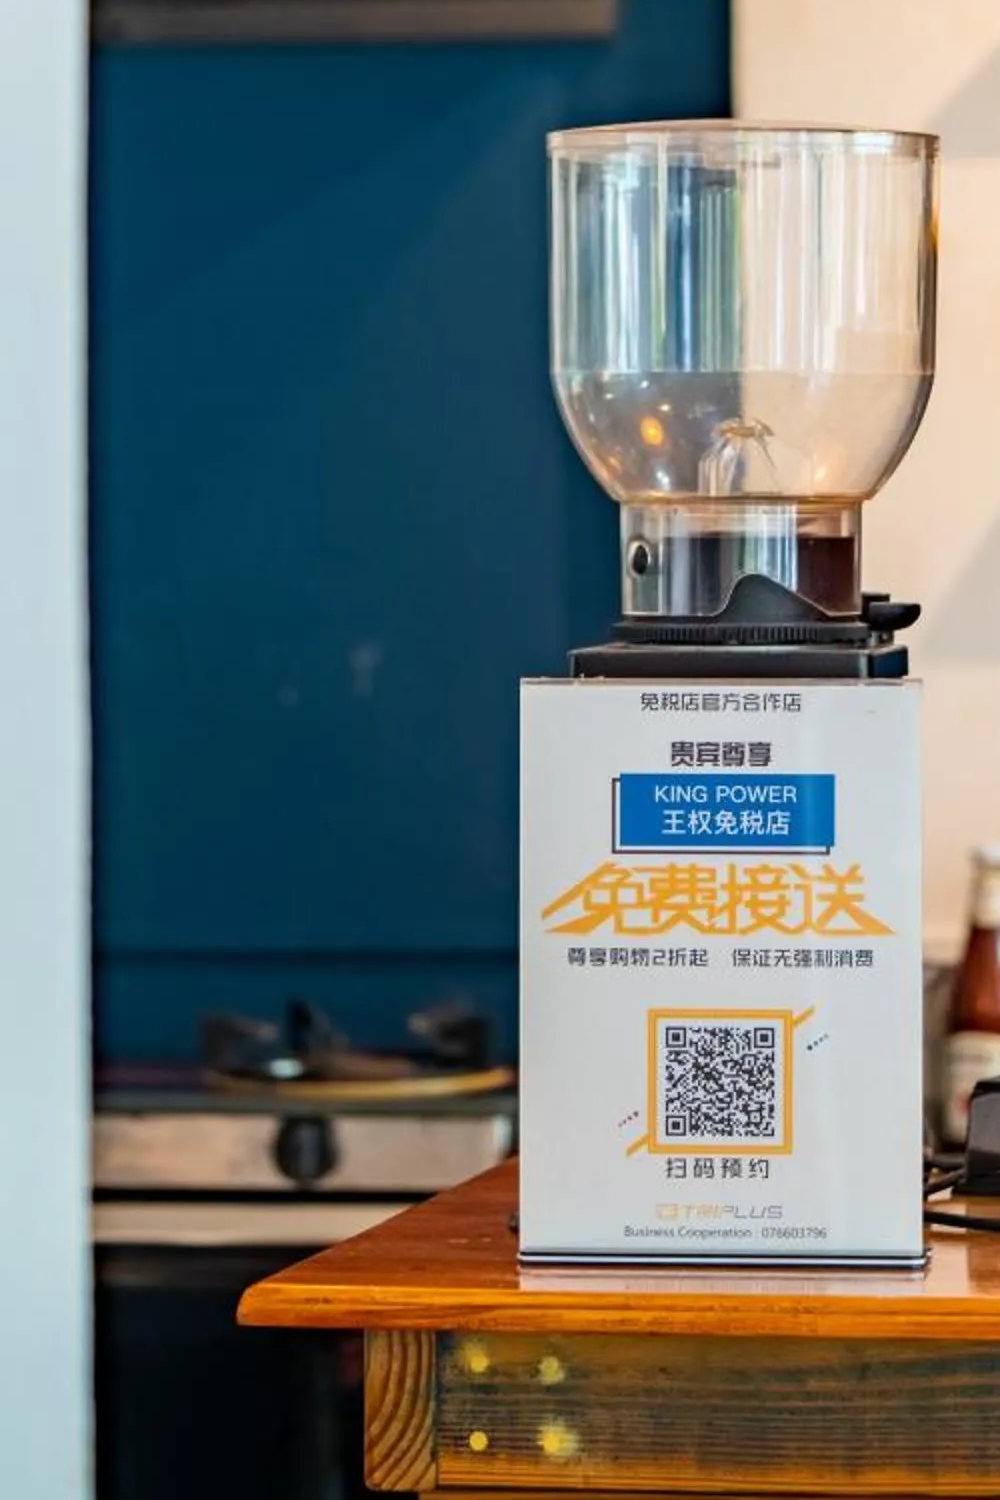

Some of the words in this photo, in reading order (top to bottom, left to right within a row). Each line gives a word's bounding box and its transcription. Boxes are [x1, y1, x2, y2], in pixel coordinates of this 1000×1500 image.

[640, 692, 801, 712] 免税店官方合作店
[670, 741, 772, 767] 贵宾尊享
[654, 785, 708, 803] KING
[716, 785, 798, 803] POWER
[662, 810, 790, 836] 王权免税店
[541, 861, 896, 936] 免费接送
[567, 947, 708, 967] 尊享购物2折起
[666, 1158, 770, 1179] 扫码预约
[624, 1225, 675, 1238] Business
[678, 1226, 753, 1240] Cooperation
